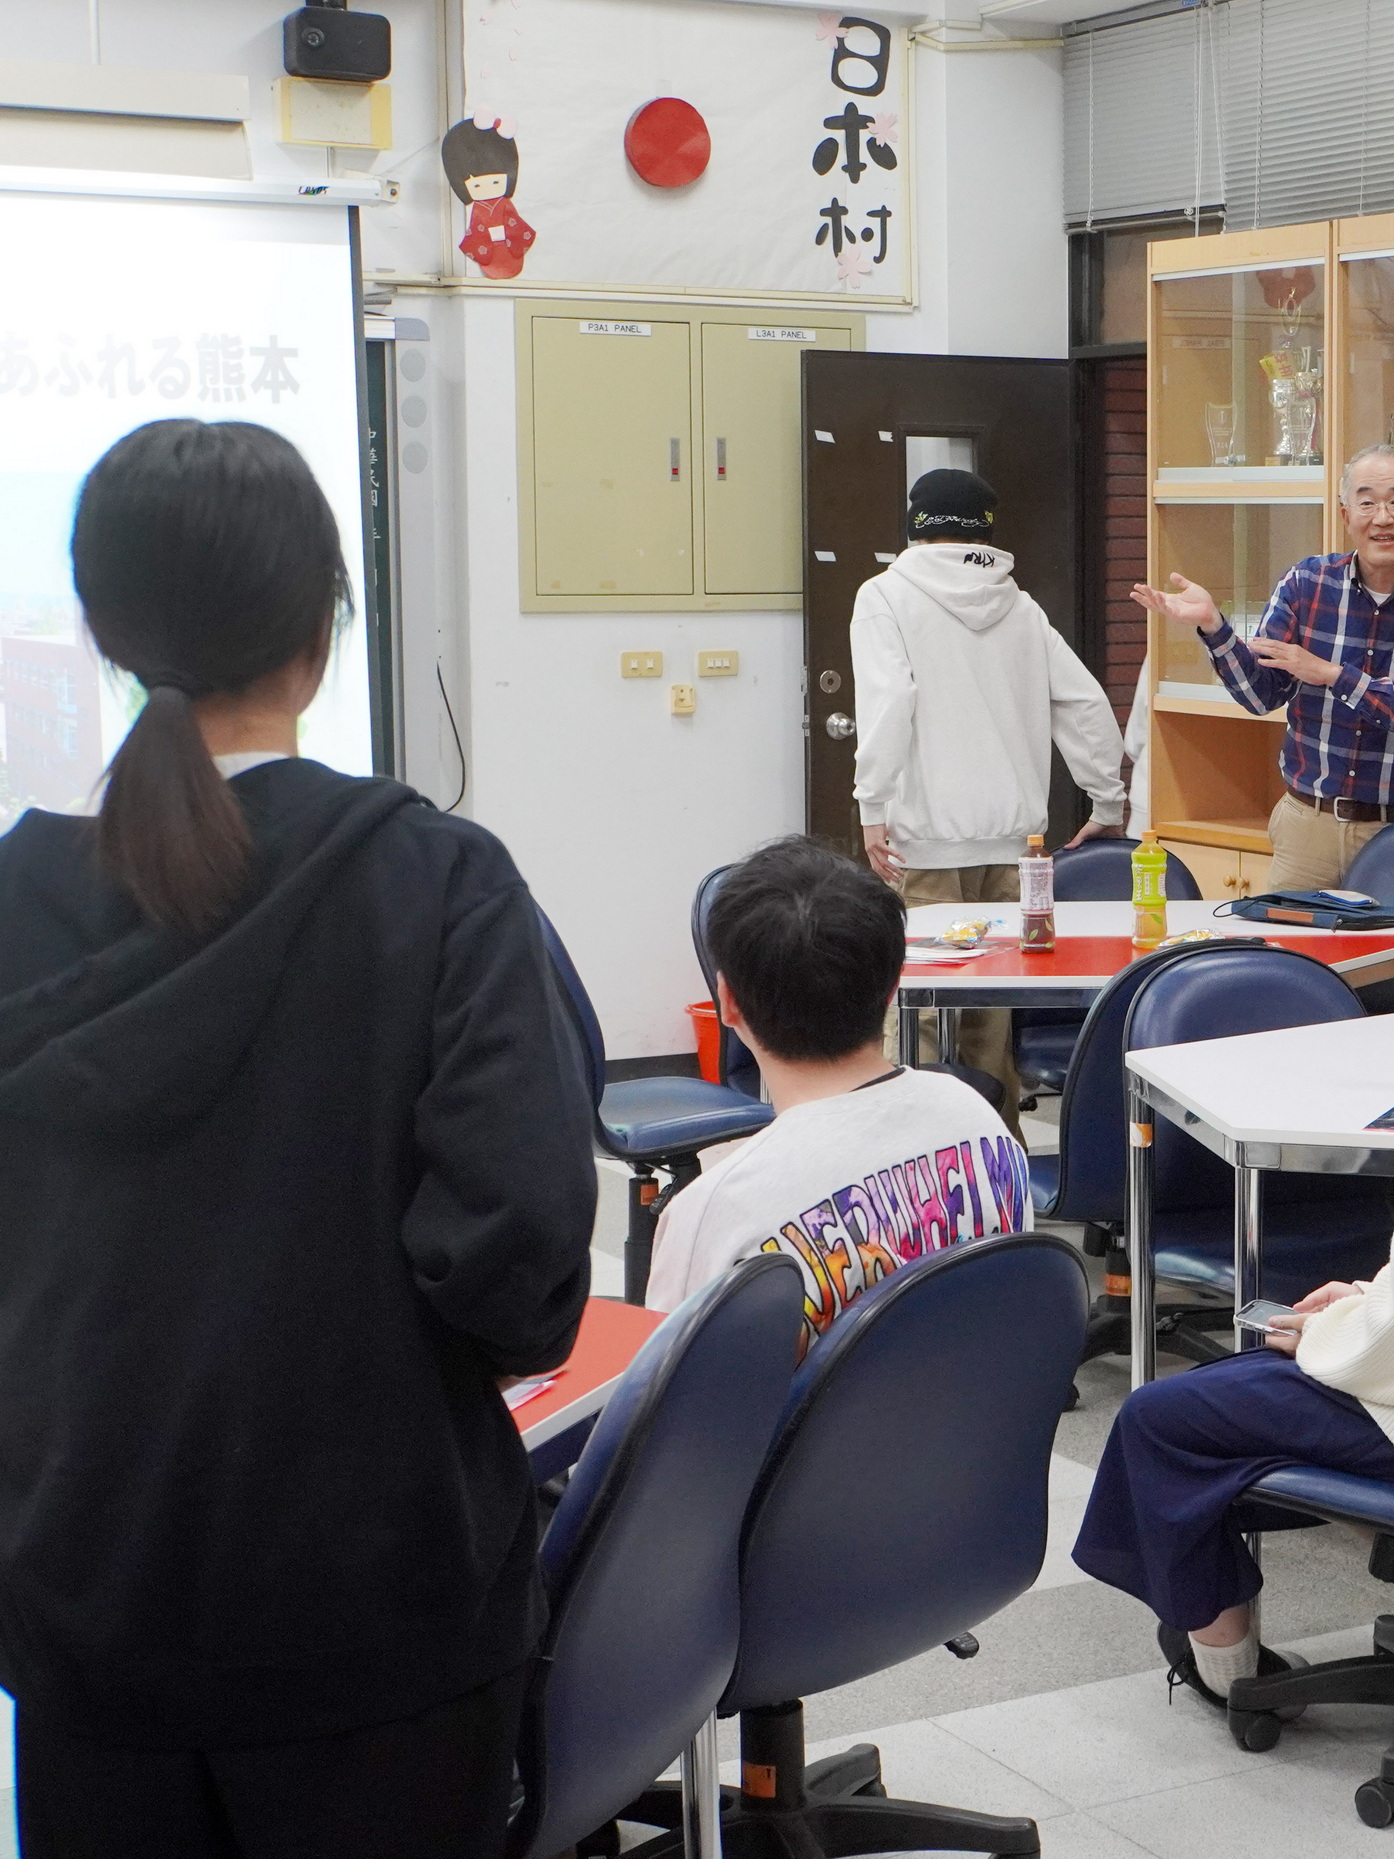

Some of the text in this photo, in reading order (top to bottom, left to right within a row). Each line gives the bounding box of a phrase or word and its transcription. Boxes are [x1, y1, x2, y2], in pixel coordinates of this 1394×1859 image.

[812, 16, 898, 264] 日本村
[588, 323, 642, 334] P3A1 PANEL
[756, 329, 807, 339] L3A1 PANEL
[0, 328, 301, 404] あふれる熊本
